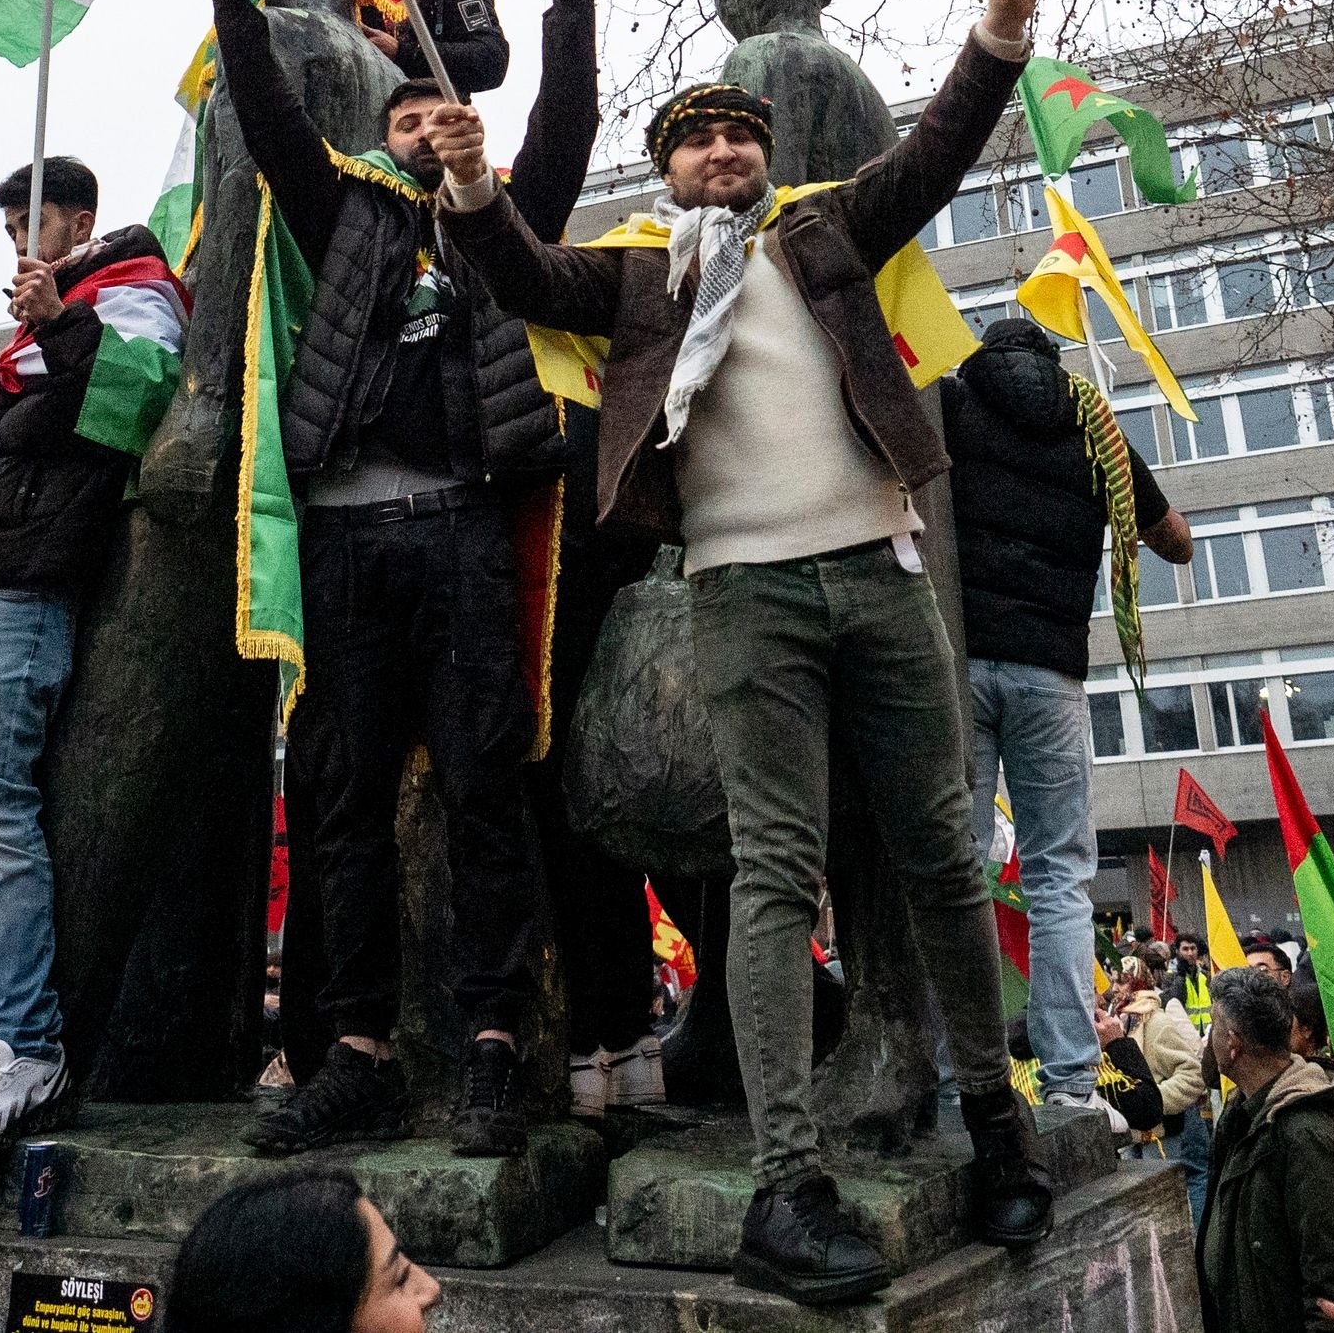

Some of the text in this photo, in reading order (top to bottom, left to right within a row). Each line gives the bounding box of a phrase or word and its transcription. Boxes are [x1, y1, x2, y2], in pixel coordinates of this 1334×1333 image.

[424, 312, 440, 327] BUT
[60, 1277, 104, 1304] SÖYLEŞİ
[34, 1300, 76, 1316] Emperyalist
[77, 1304, 91, 1318] güç
[22, 1315, 40, 1327] dünü
[41, 1319, 49, 1329] ve
[50, 1317, 78, 1332] bugünü
[79, 1320, 89, 1332] ile
